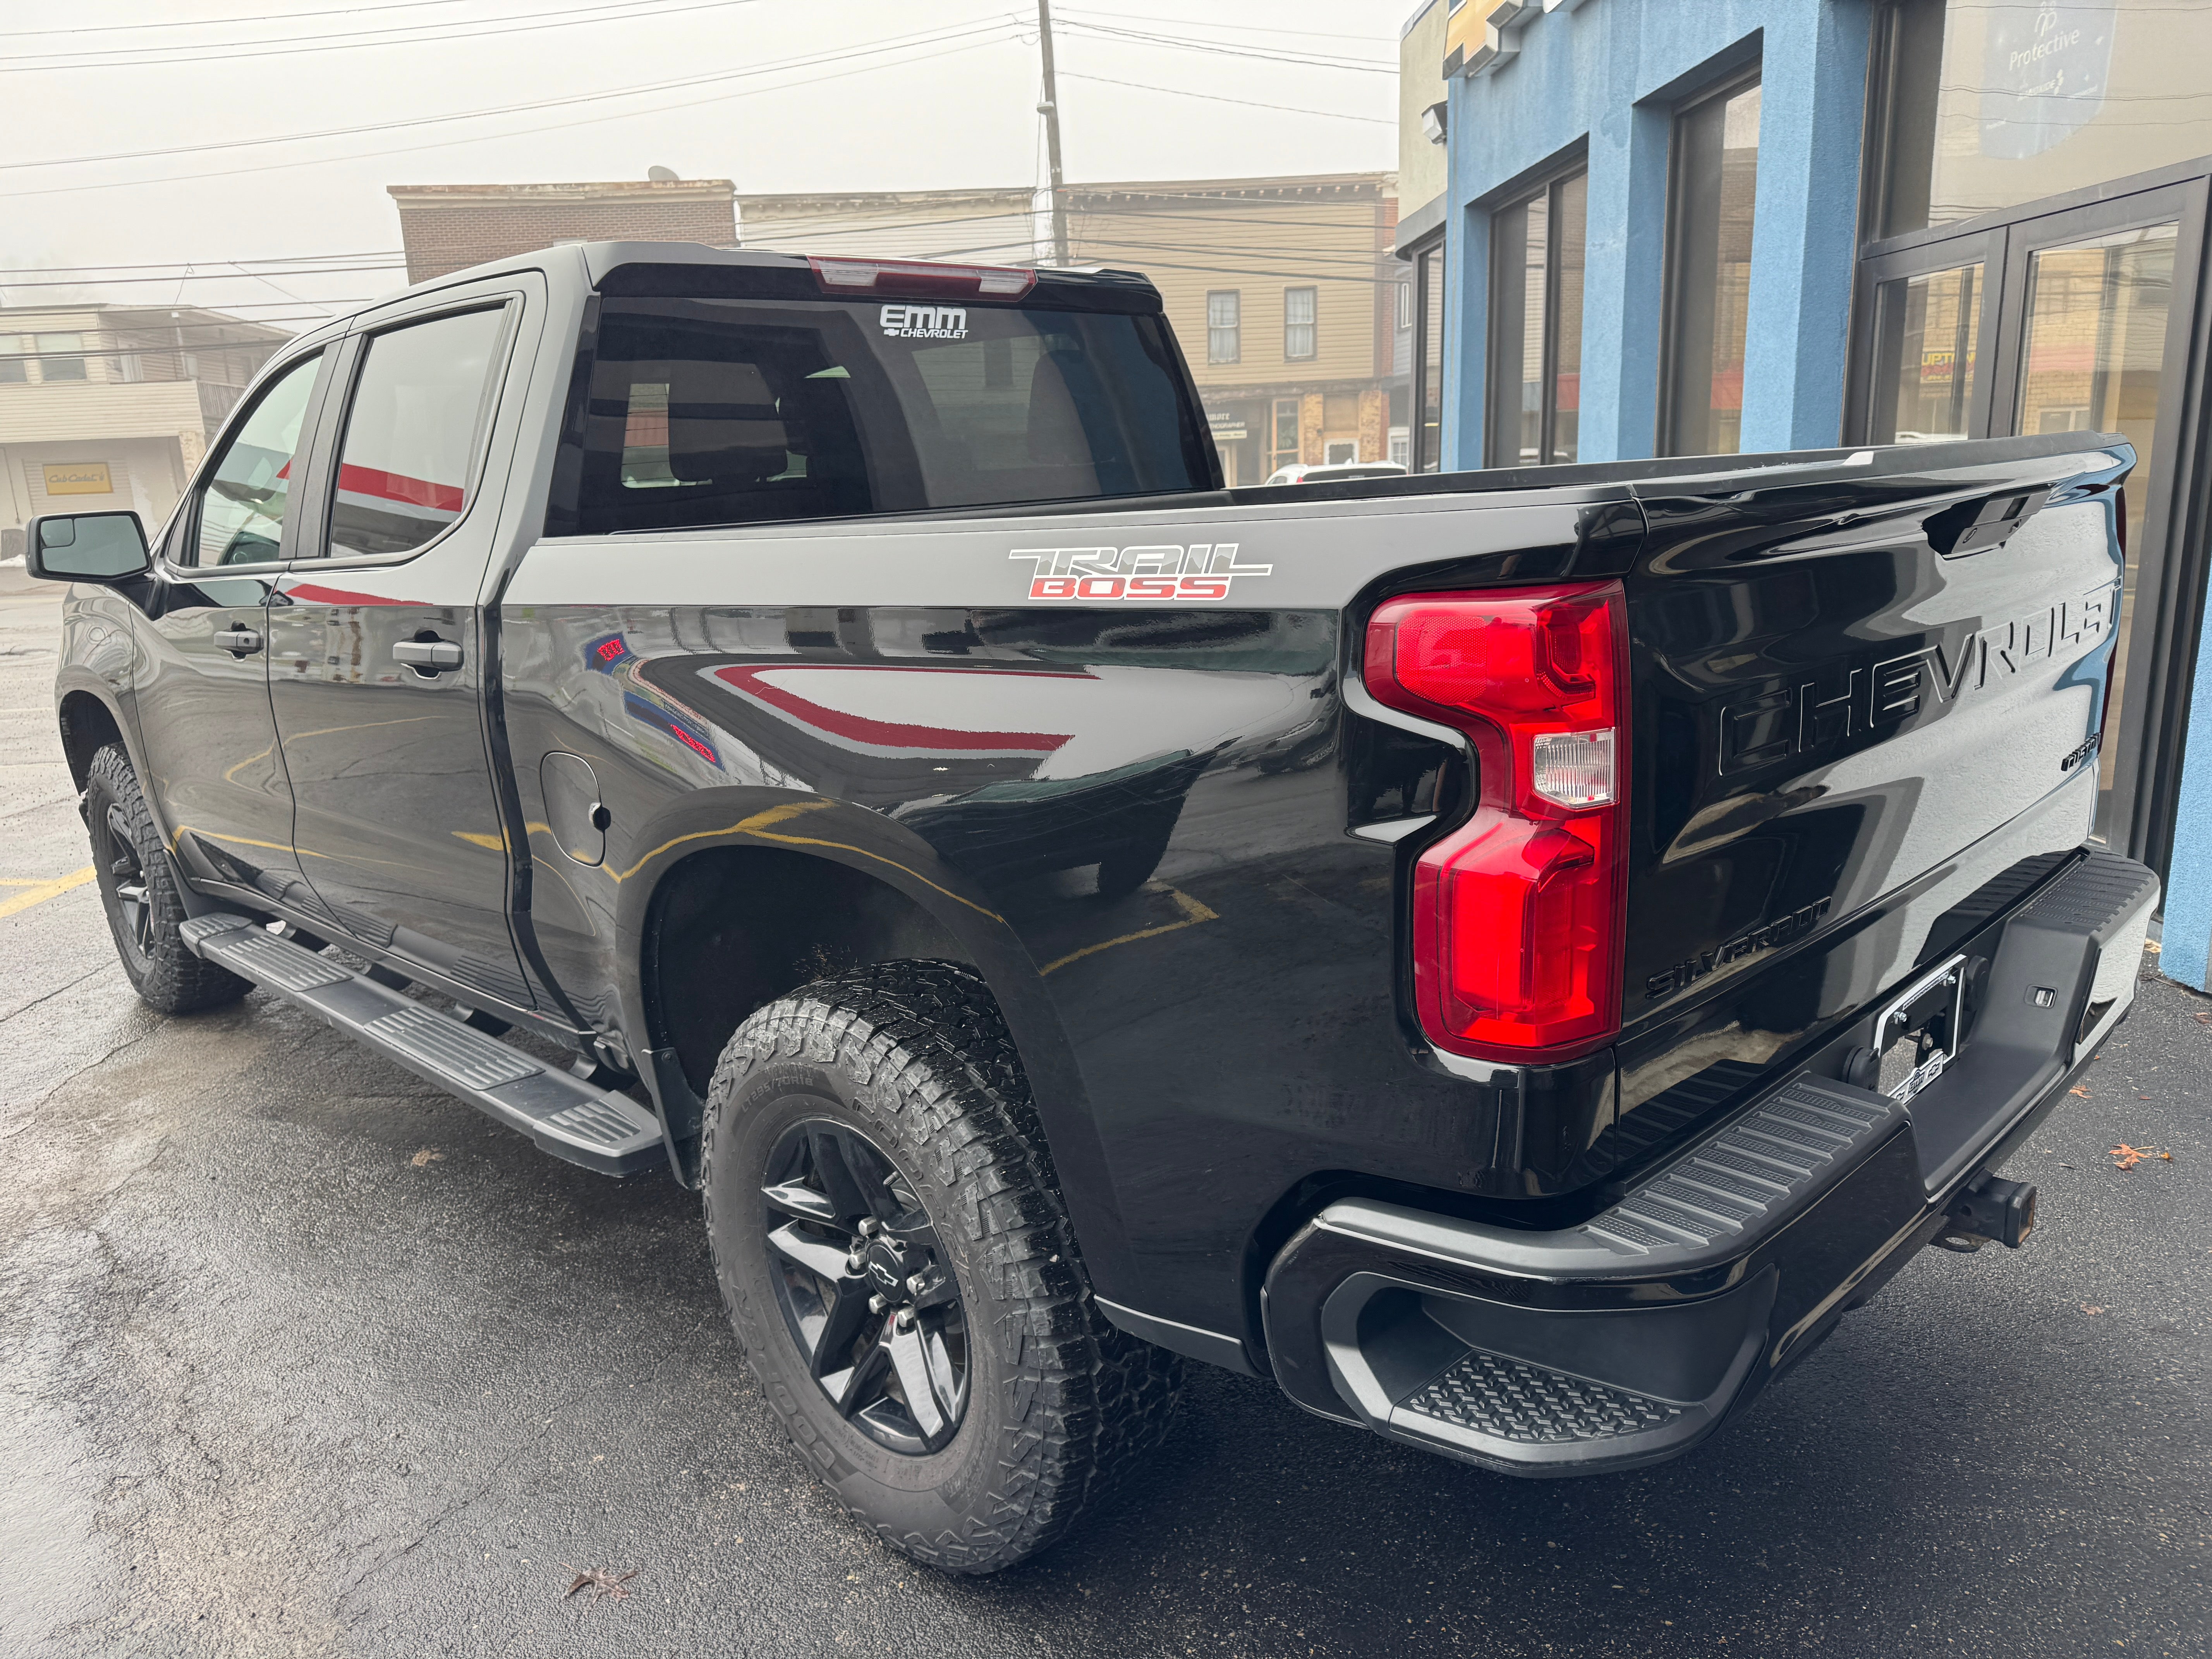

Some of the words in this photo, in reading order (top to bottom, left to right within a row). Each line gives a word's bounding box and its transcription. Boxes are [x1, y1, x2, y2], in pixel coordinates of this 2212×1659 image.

[2009, 29, 2080, 71] Protective
[900, 328, 968, 339] CHEVROLET
[49, 474, 68, 483] Cub
[68, 474, 97, 483] Cadet
[1008, 543, 1273, 577] TRAIL
[1028, 575, 1232, 601] BOSS
[1718, 575, 2123, 777] CHEVROLET
[1645, 896, 1832, 1000] SILVERADO
